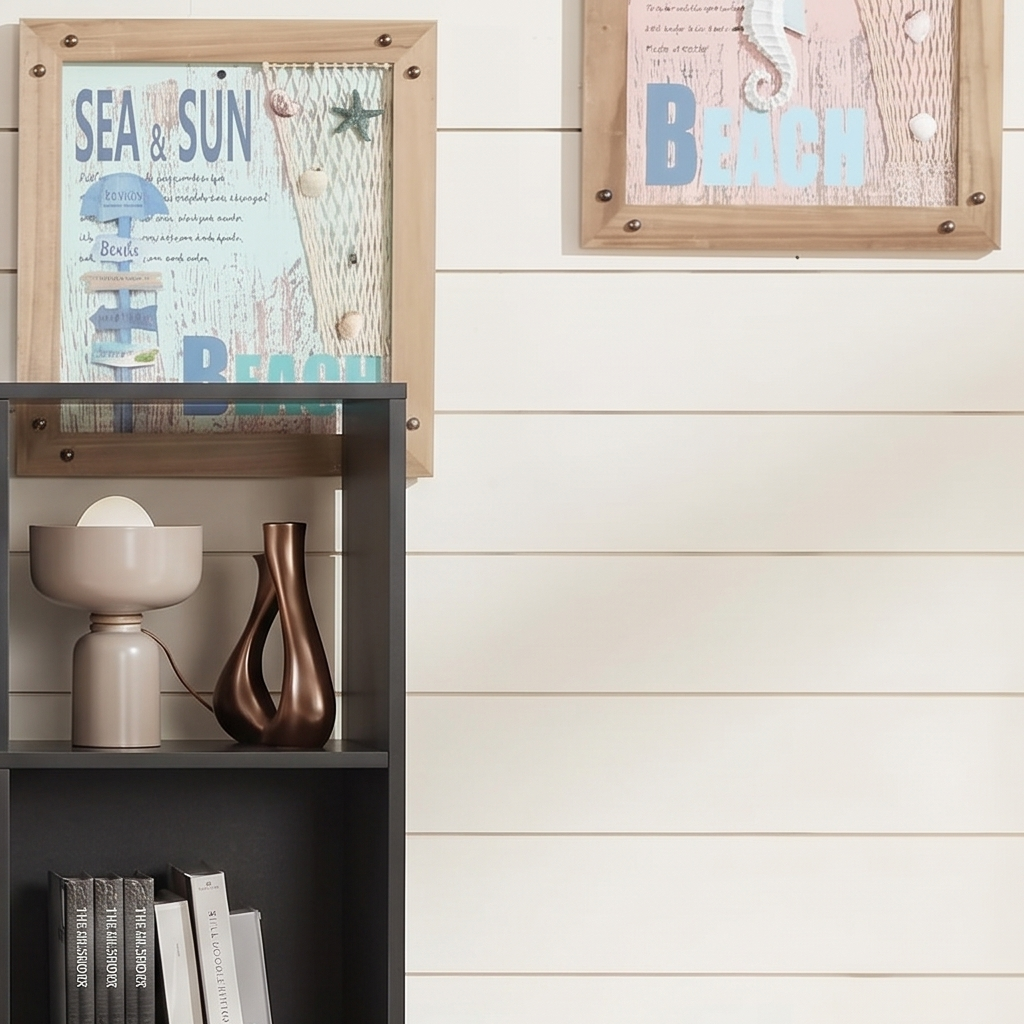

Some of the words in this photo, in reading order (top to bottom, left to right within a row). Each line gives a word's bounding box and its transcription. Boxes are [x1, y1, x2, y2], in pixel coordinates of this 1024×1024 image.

[75, 88, 140, 163] SEA
[150, 123, 167, 162] &
[178, 88, 251, 163] SUN
[645, 83, 865, 186] BEACH
